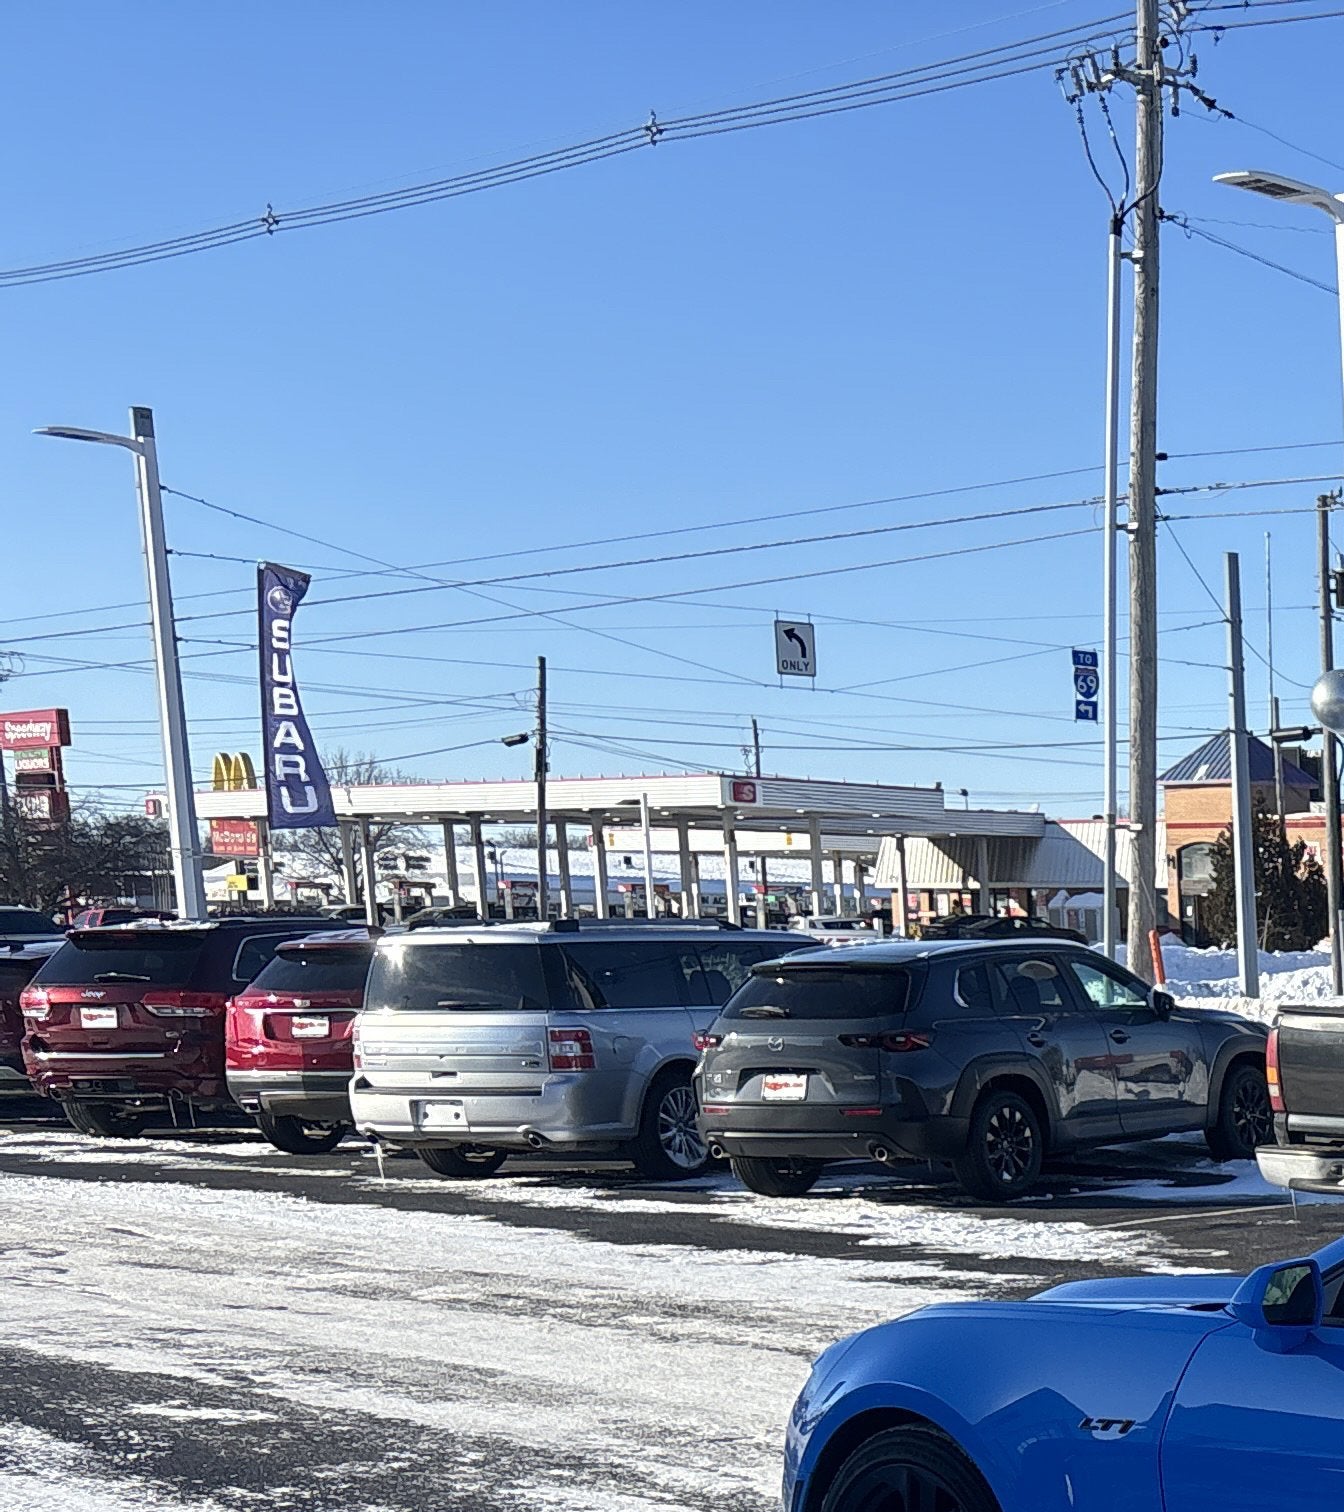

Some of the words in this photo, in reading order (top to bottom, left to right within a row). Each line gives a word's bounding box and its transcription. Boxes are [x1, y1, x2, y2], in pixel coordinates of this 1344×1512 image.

[781, 659, 810, 671] ONLY
[1078, 654, 1092, 664] TO
[1077, 676, 1097, 693] 69
[272, 619, 318, 814] SUBARU
